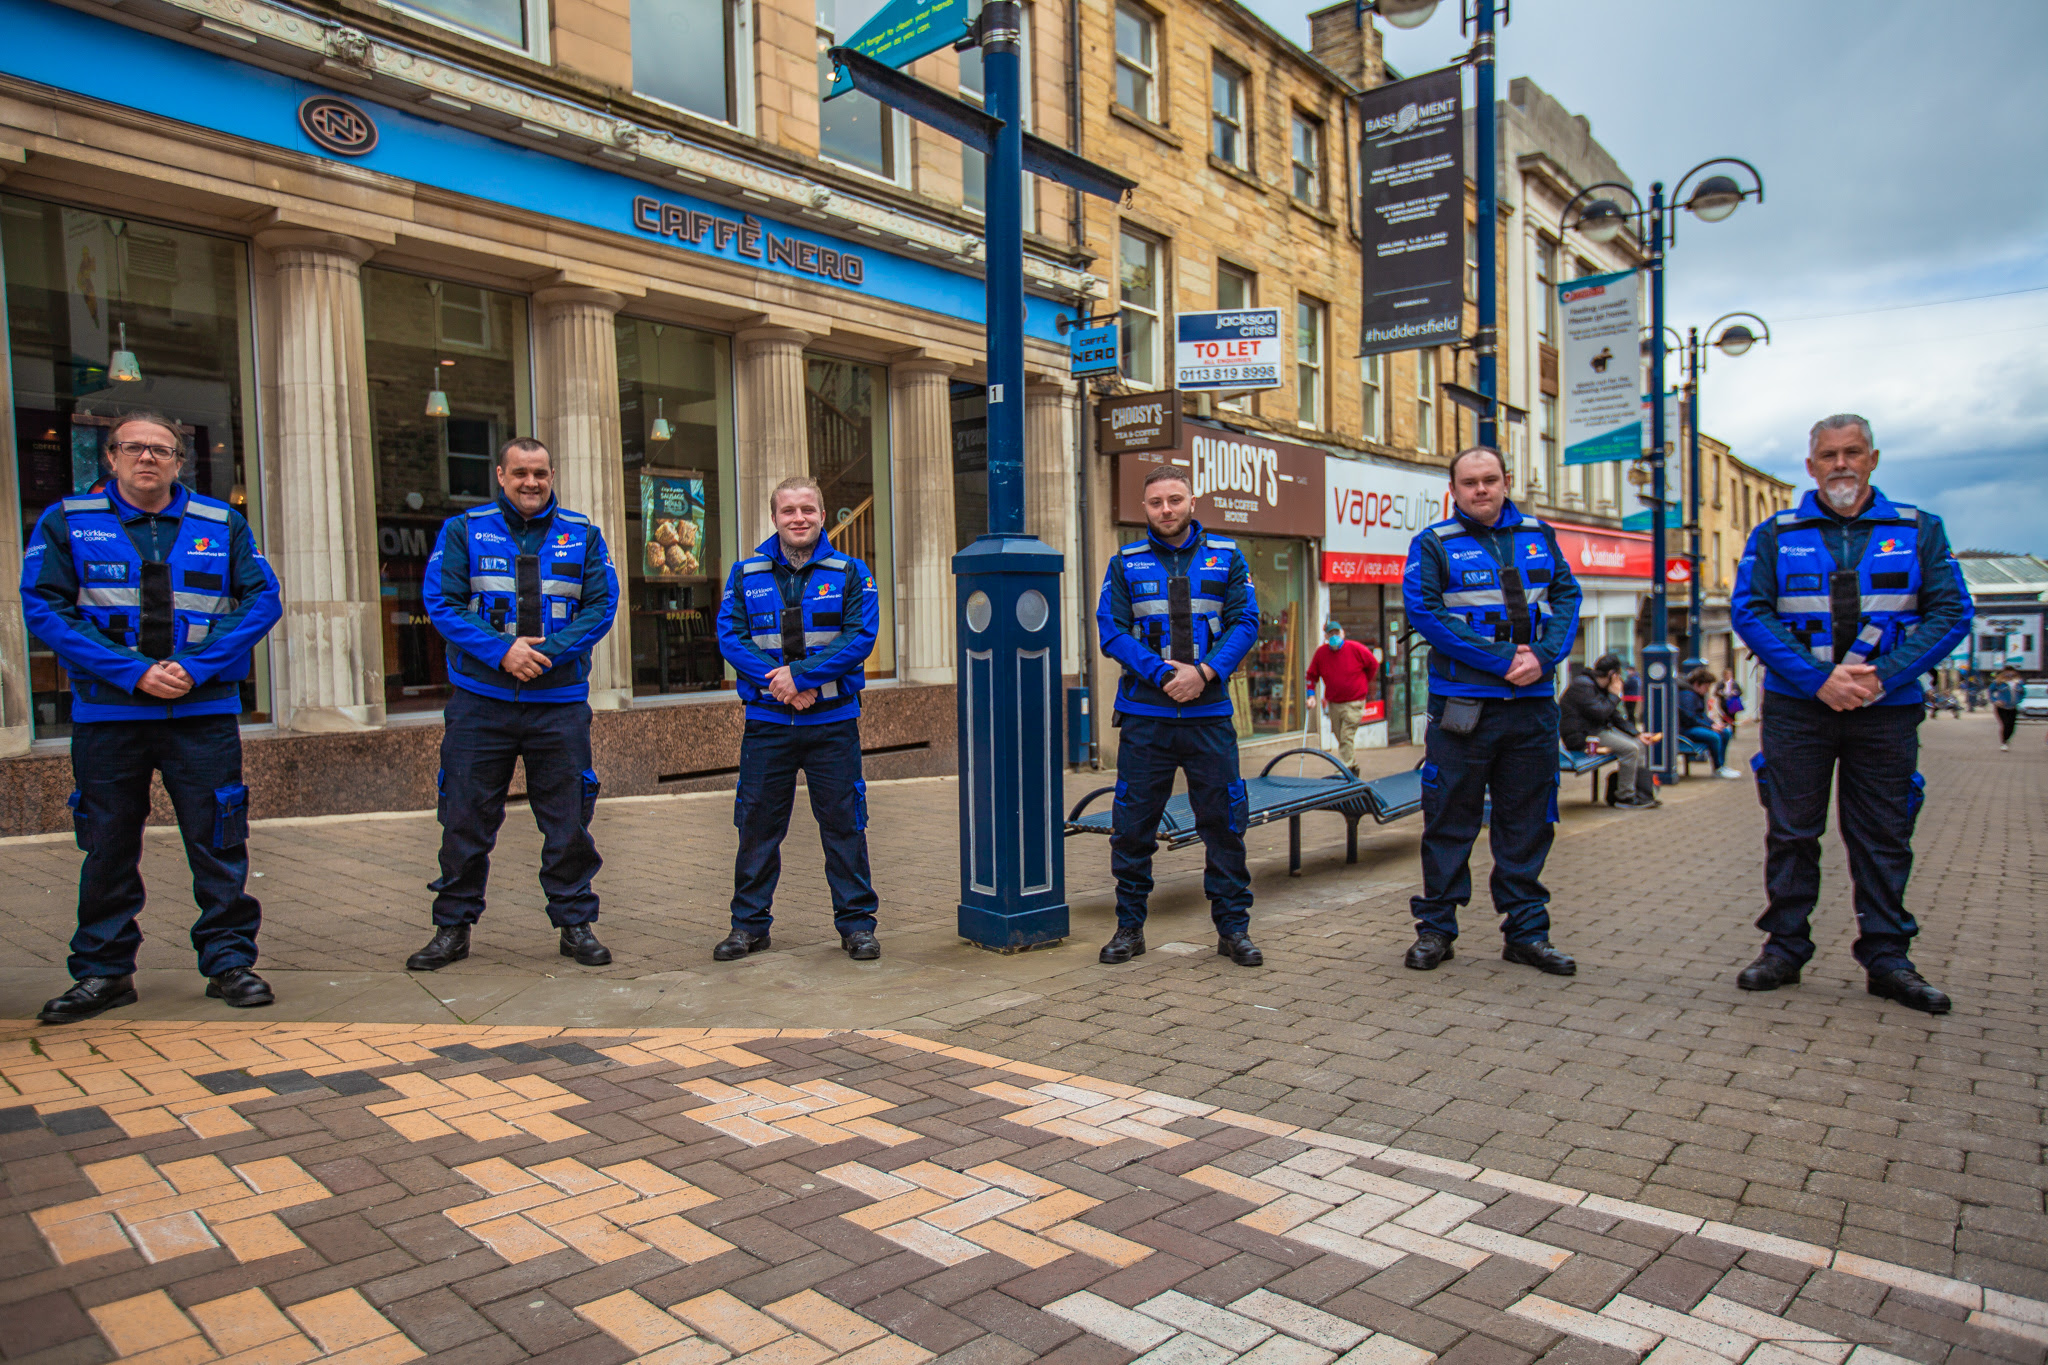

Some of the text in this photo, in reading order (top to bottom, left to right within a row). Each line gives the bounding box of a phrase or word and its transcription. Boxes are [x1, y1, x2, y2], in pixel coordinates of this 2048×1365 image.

[866, 32, 885, 46] forget
[887, 28, 894, 36] to
[896, 18, 913, 32] clean
[915, 9, 930, 23] your
[876, 42, 892, 54] soon
[893, 37, 902, 45] as
[903, 30, 915, 43] you
[1418, 97, 1456, 118] MENT
[634, 194, 864, 284] CAFFÈ NERO
[1216, 313, 1276, 330] jackson
[1365, 315, 1459, 343] #huddersfield
[1240, 325, 1276, 337] criss
[1072, 347, 1115, 364] NERO
[1194, 340, 1261, 358] TO LET
[1180, 366, 1276, 381] 0113 819 8998
[1111, 403, 1163, 430] CHOOSY'S
[1114, 431, 1130, 439] TEA
[1134, 428, 1160, 437] COFFEE
[1125, 437, 1149, 446] HOUSE
[1192, 435, 1278, 507] CHOOSY'S
[1213, 497, 1228, 508] TEA
[1233, 499, 1259, 512] COFFEE
[1333, 486, 1441, 538] vapesuite
[1224, 511, 1249, 523] HOUSE
[82, 529, 117, 539] Kirklees
[1592, 543, 1625, 568] Santander
[1332, 560, 1356, 577] e-cigs
[1364, 562, 1383, 577] vape
[1383, 561, 1400, 575] units
[751, 586, 773, 595] Kirklees
